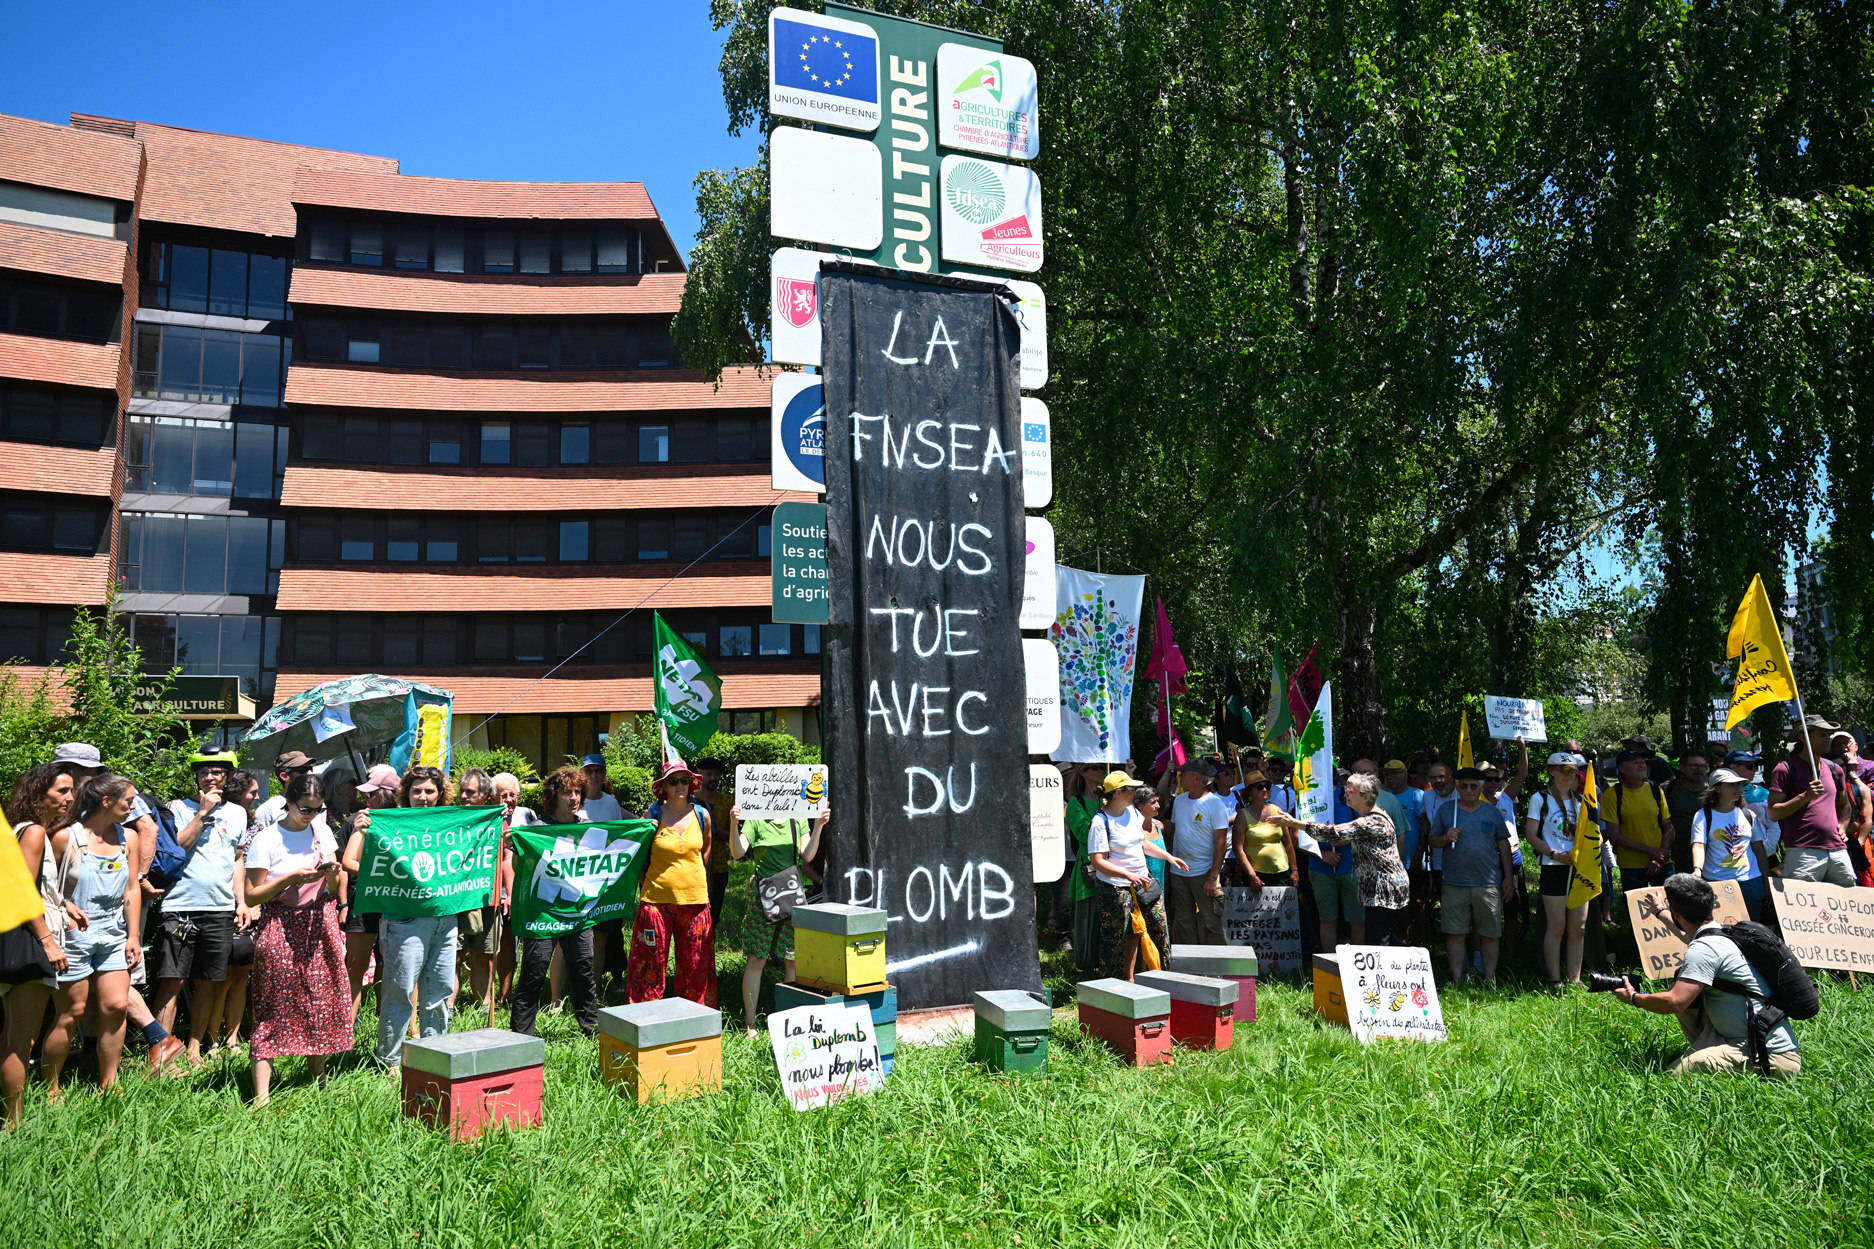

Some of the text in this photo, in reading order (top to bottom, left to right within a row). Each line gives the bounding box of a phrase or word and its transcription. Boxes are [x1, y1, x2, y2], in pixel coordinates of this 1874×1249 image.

[774, 93, 878, 120] UNION EUROPEENNE
[953, 124, 1029, 145] CHAMBRE D'AGRICULTURE
[958, 114, 1028, 135] & TERRITOIRES
[889, 54, 932, 272] CULTURE
[955, 186, 997, 210] fdsea
[993, 226, 1027, 239] Jeunes
[986, 243, 1041, 259] Agriculteurs
[881, 310, 959, 370] LA
[849, 411, 1017, 475] FNSEA
[1031, 450, 1047, 458] 640
[1024, 468, 1048, 477] Basque
[782, 523, 828, 539] Soutie
[782, 543, 805, 558] les
[866, 514, 993, 575] NOUS
[783, 563, 796, 578] la
[869, 604, 980, 657] TUE
[677, 705, 700, 722] FSU
[867, 679, 990, 736] AVEC
[673, 732, 697, 752] TIDIEN
[744, 766, 799, 784] Les abeilles
[903, 762, 976, 819] DU
[377, 825, 496, 854] Génération
[544, 852, 632, 879] SNETAP
[364, 877, 491, 900] PYRÉNÉES-ATLANTIQUES
[844, 861, 1015, 923] PLOMB
[1783, 891, 1818, 908] LOI
[588, 903, 626, 918] QUOTIDIEN
[1230, 929, 1300, 941] LES PAYSANS
[1781, 917, 1825, 934] CLASSÉE
[1353, 951, 1429, 975] 80% des plantes
[1650, 952, 1684, 971] DES
[1788, 944, 1824, 961] POUR
[1825, 948, 1848, 962] LES
[1358, 973, 1428, 995] à fleurs ont
[784, 1014, 826, 1038] La loi
[1357, 1010, 1391, 1027] besoin
[1392, 1017, 1403, 1028] des
[808, 1022, 867, 1053] Duplomb
[788, 1064, 824, 1083] nous
